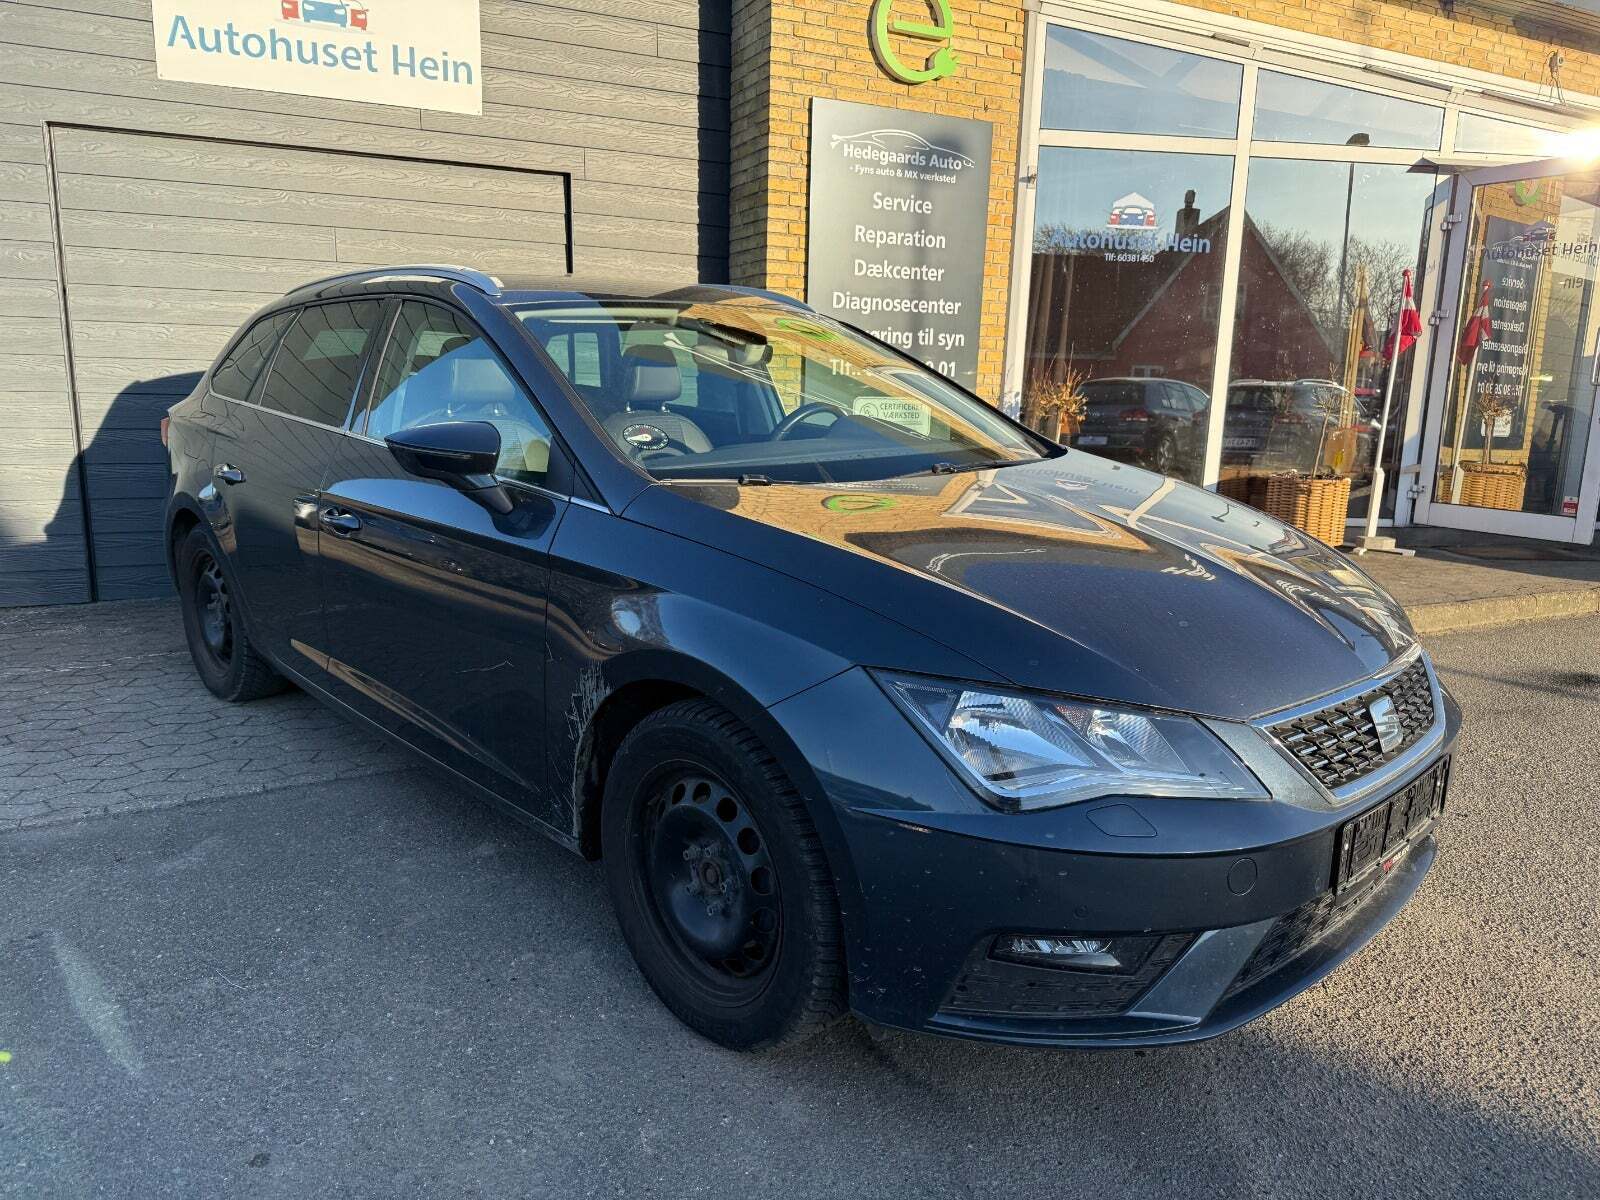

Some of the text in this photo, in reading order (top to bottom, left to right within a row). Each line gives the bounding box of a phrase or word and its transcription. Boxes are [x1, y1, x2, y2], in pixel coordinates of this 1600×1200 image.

[166, 14, 473, 85] Autohuset Hein
[843, 143, 962, 170] Hedegaards Auto
[855, 163, 874, 176] Fyns
[875, 165, 895, 178] auto
[896, 168, 903, 178] &
[904, 169, 918, 180] MX
[919, 171, 957, 184] værksted
[873, 191, 933, 214] Service
[854, 224, 946, 249] Reparation
[1049, 228, 1211, 254] Autohuset Hein
[854, 259, 945, 282] Dækcenter
[832, 291, 962, 315] Diagnosecenter
[917, 328, 934, 346] til
[938, 332, 965, 351] syn
